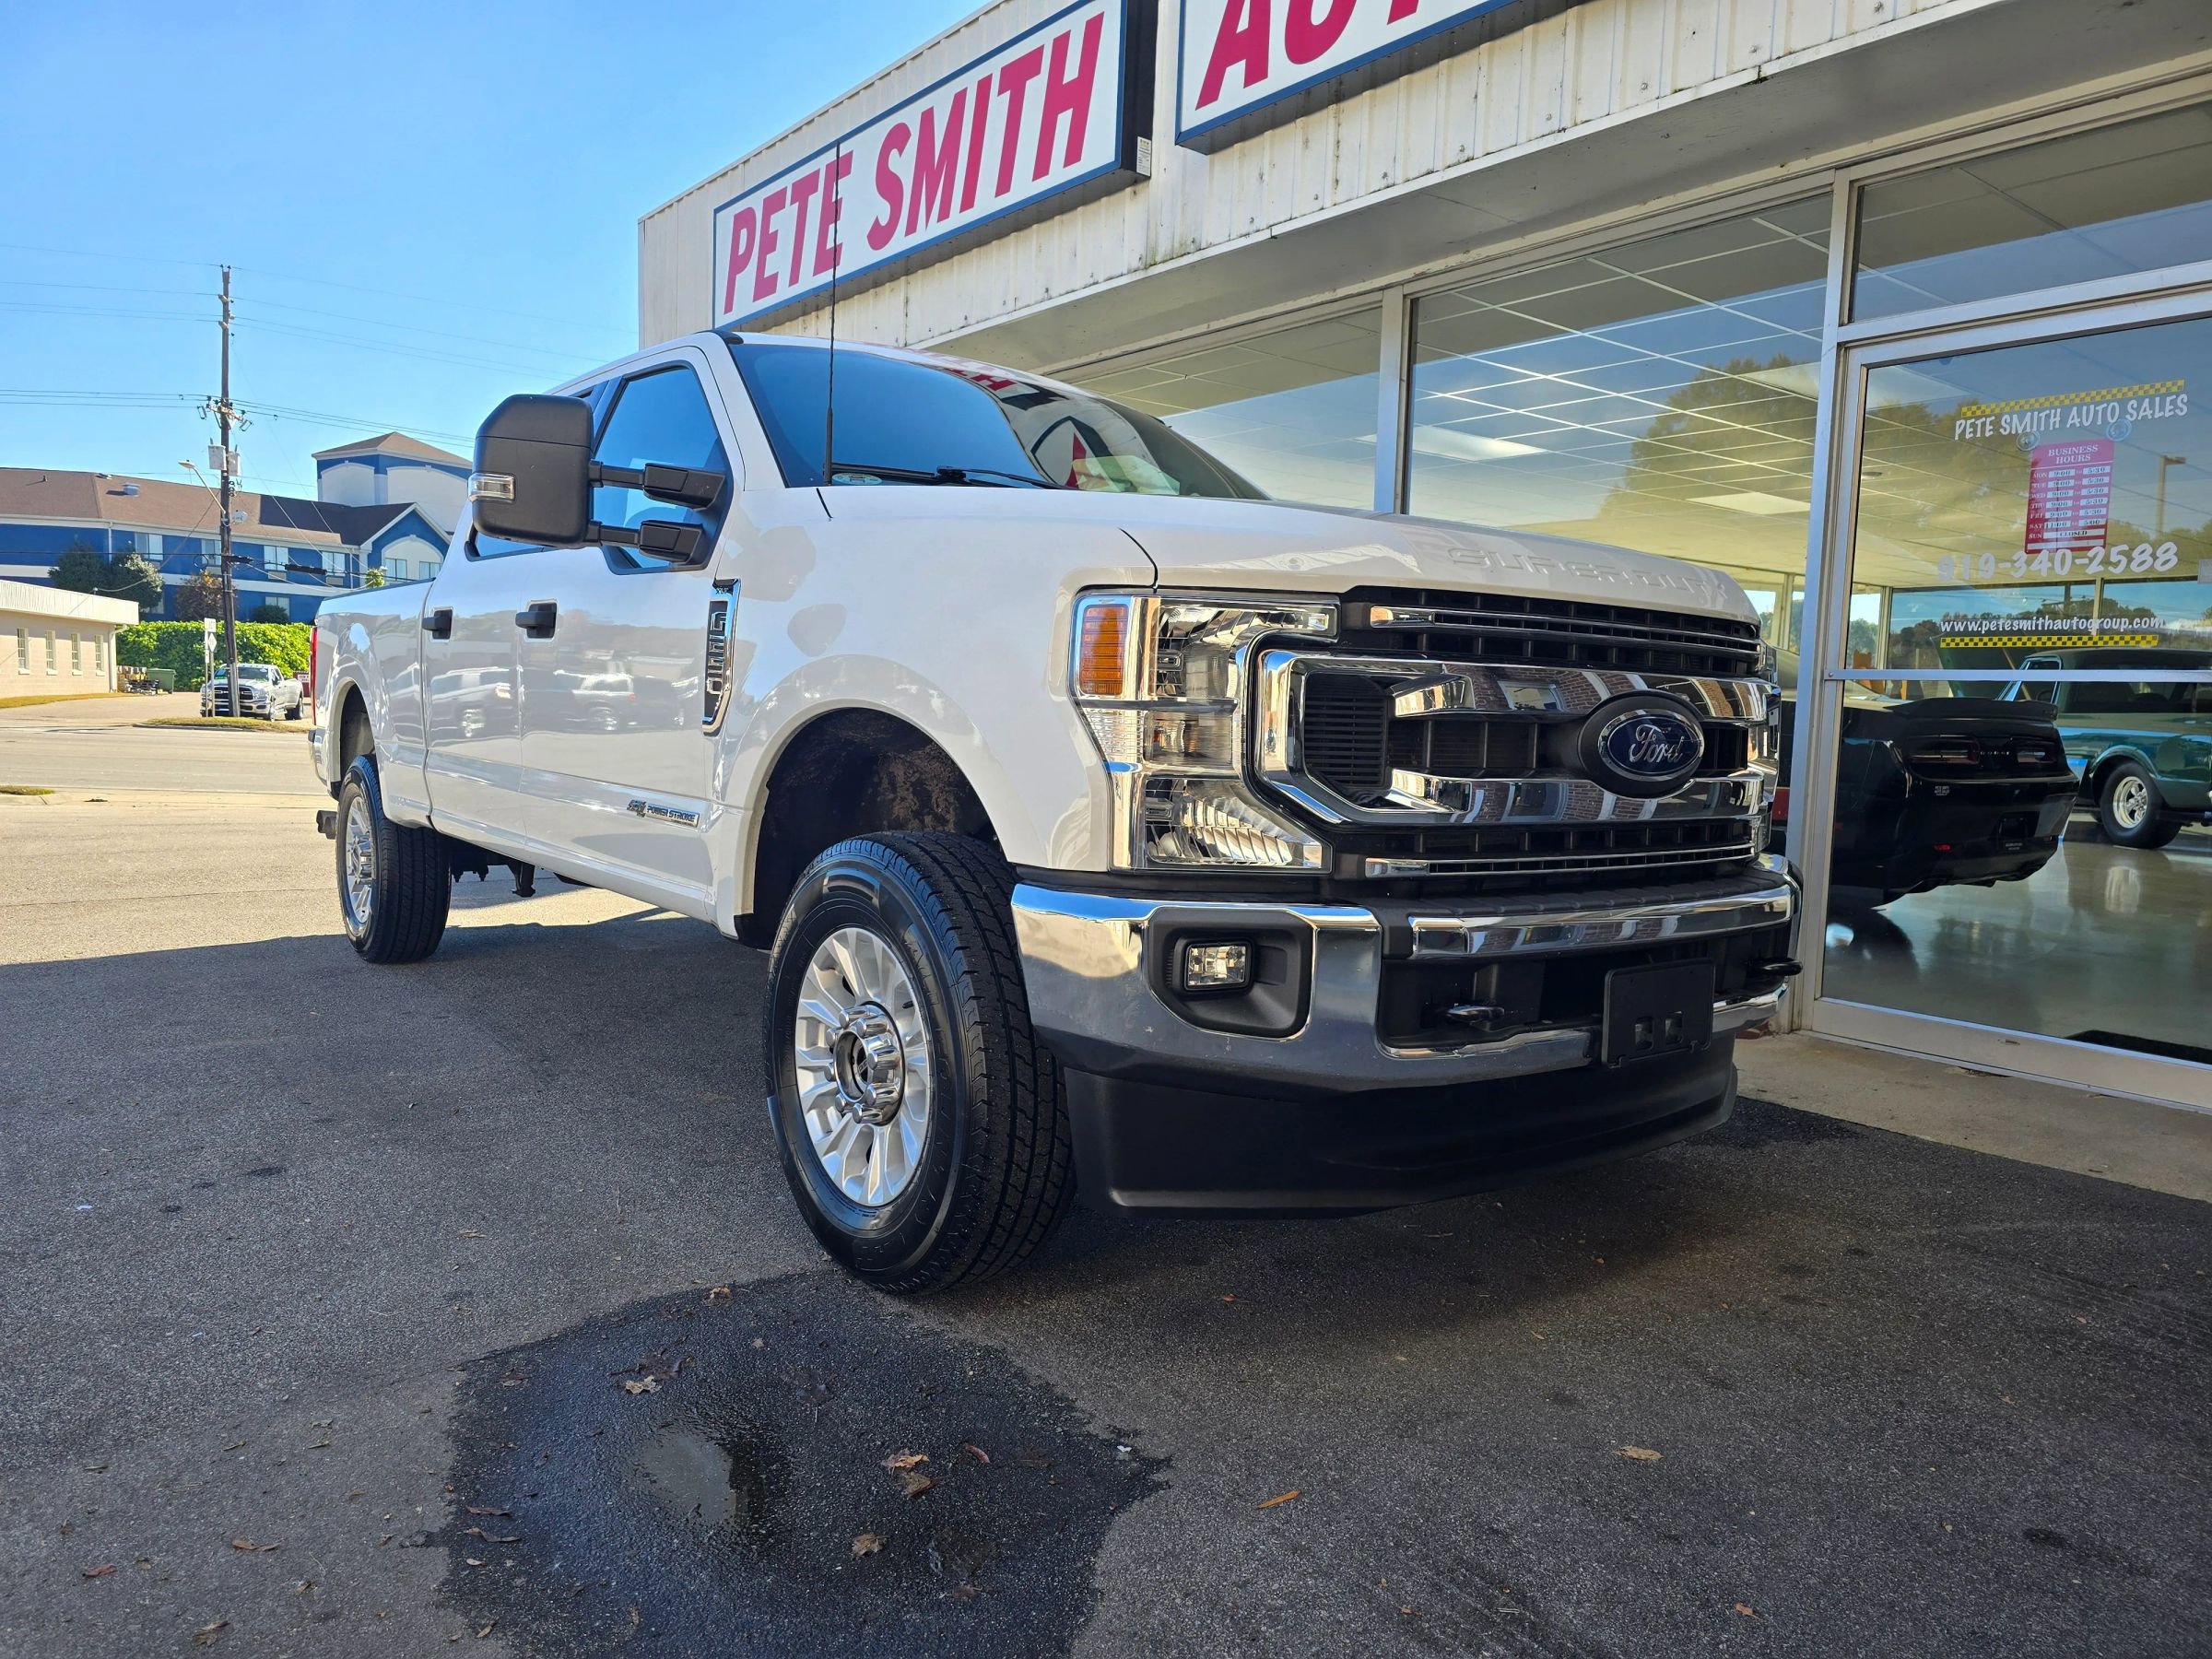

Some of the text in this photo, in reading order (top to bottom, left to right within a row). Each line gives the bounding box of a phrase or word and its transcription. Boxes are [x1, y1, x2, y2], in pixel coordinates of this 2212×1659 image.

[724, 12, 1104, 315] PETE SMITH
[1955, 394, 2188, 441] PETE SMITH AUTO SALES
[2048, 444, 2099, 457] BUSINESS
[2056, 453, 2091, 464] HOURS
[1937, 542, 2179, 581] 919-340-2588
[1940, 615, 2164, 633] www.petesmithautogroup.com
[1629, 724, 1685, 763] Ford
[647, 805, 668, 818] POWER
[668, 810, 696, 822] STROKE
